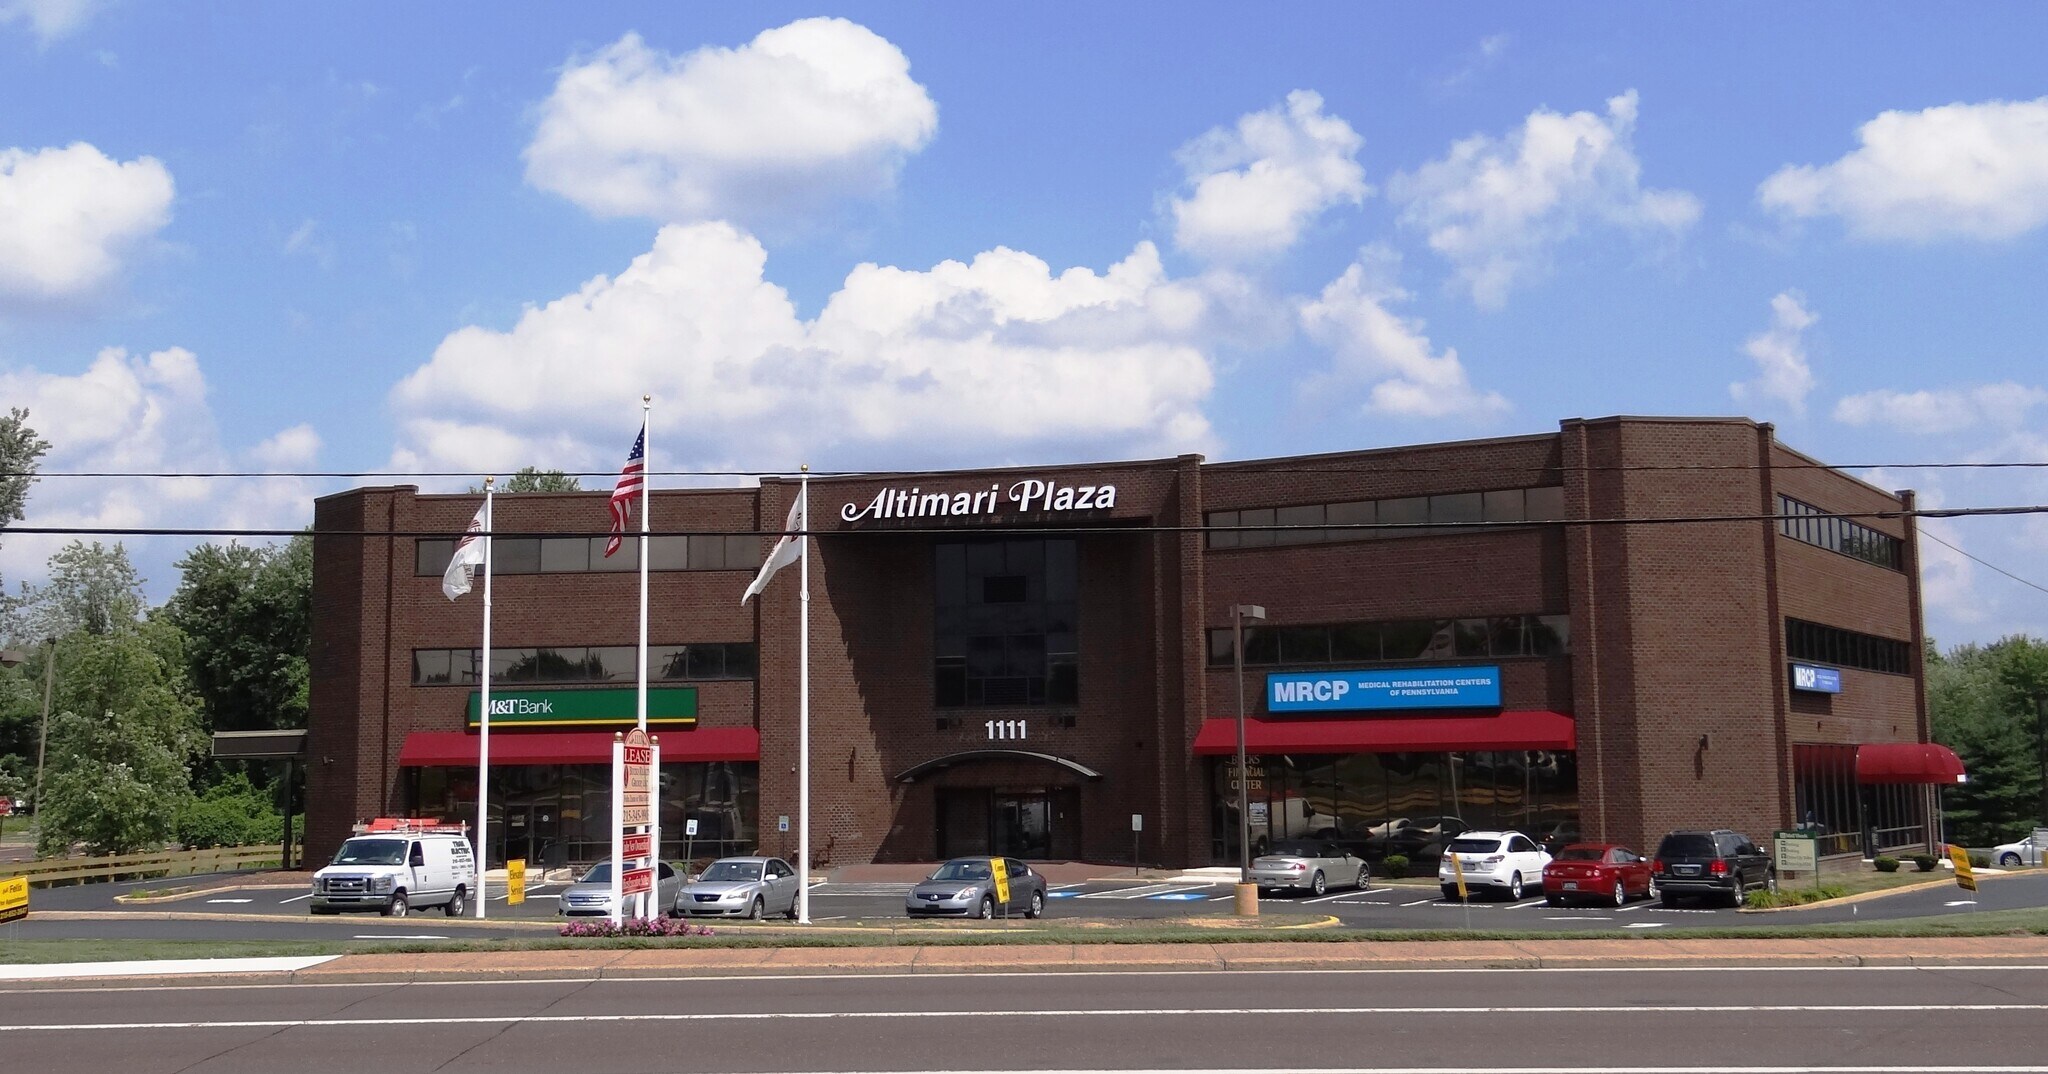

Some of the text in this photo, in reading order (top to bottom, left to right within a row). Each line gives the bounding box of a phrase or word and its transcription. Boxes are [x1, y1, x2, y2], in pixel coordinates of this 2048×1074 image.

[841, 479, 1117, 522] Altimari Plaza
[1795, 667, 1815, 688] MRCP
[1273, 678, 1492, 703] MRCP MEDICAL REHABILITATION CENTERS
[1389, 688, 1459, 697] OF PENNSYLVANIA
[518, 698, 553, 715] Bank
[985, 719, 1027, 740] 1111
[624, 748, 651, 763] LEASE
[1231, 755, 1260, 765] BCKS
[1228, 766, 1265, 777] FINCIAL
[1230, 779, 1262, 790] CETER
